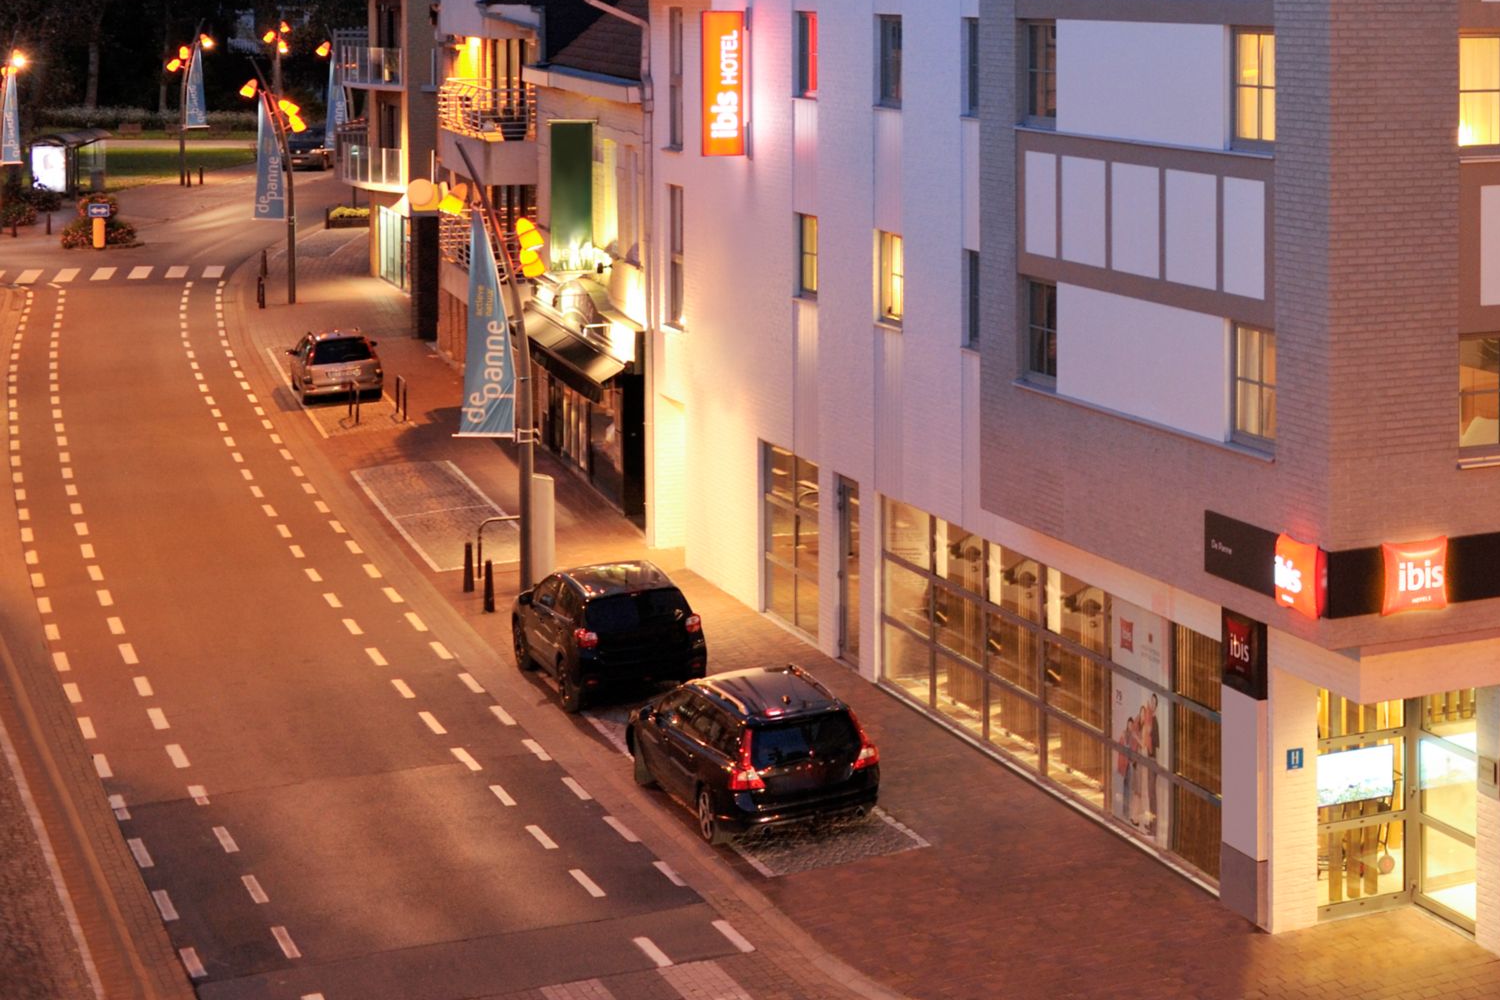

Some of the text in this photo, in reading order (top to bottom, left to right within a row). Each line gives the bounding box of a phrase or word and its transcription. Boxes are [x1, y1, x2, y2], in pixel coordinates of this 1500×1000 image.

[710, 30, 738, 138] ibis HOTEL
[256, 195, 269, 214] de
[267, 156, 284, 200] panne
[462, 320, 514, 424] de panne
[1398, 560, 1444, 592] ibis
[1230, 632, 1250, 663] ibis
